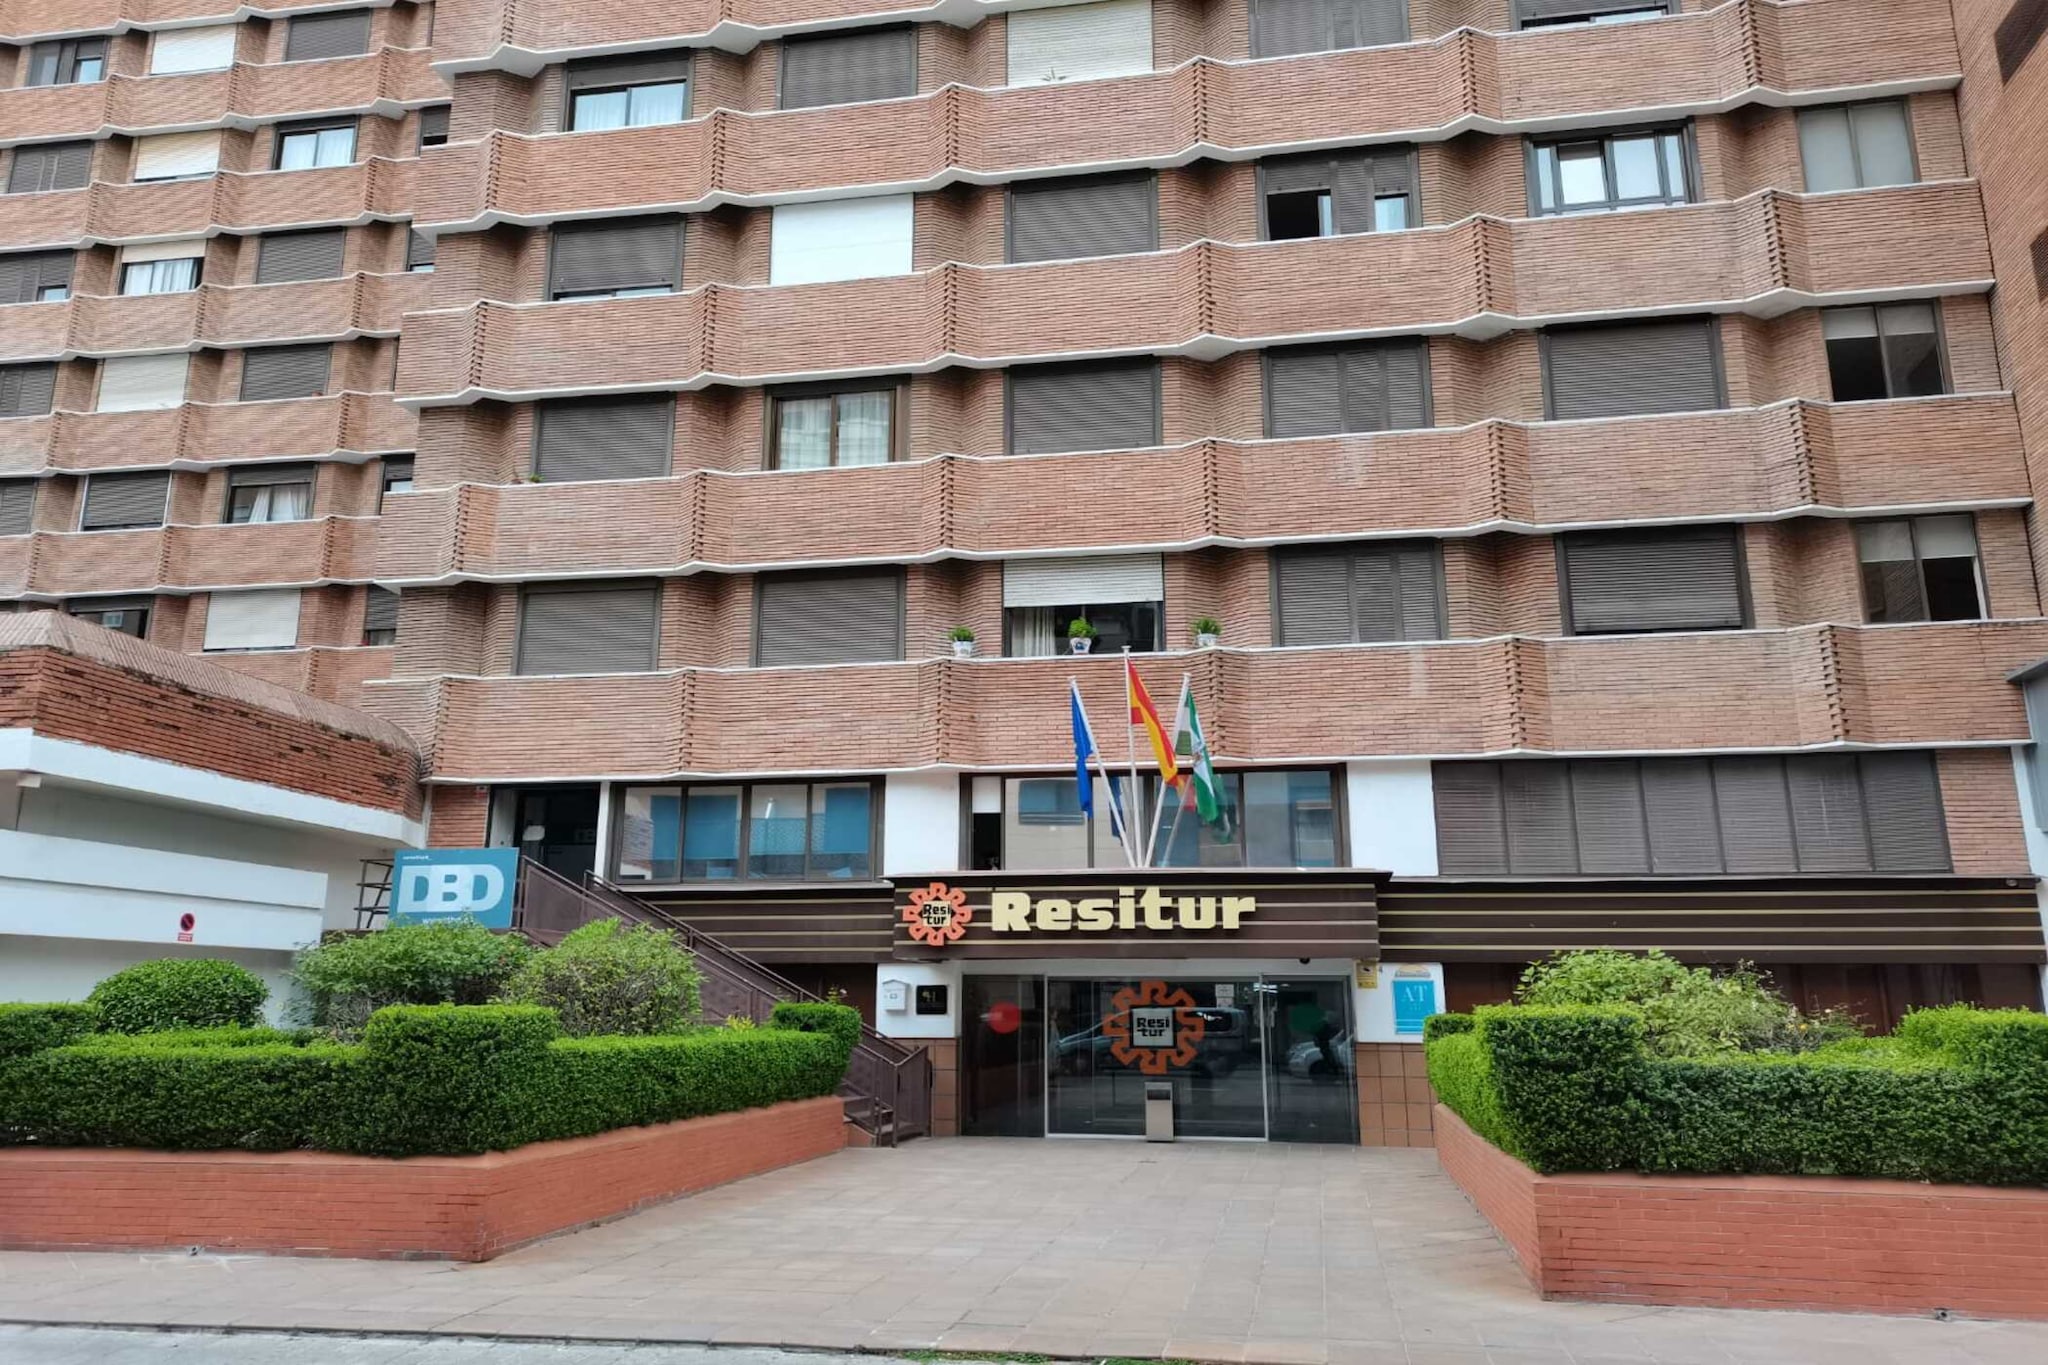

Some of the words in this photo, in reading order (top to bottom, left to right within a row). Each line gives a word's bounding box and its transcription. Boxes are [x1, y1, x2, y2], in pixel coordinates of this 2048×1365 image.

[396, 864, 504, 913] DBD
[923, 904, 951, 915] Resi
[991, 887, 1256, 931] Resitur
[923, 915, 946, 925] tur
[1401, 984, 1428, 1002] AT
[1136, 1017, 1170, 1028] Resi
[1137, 1028, 1165, 1036] tur
